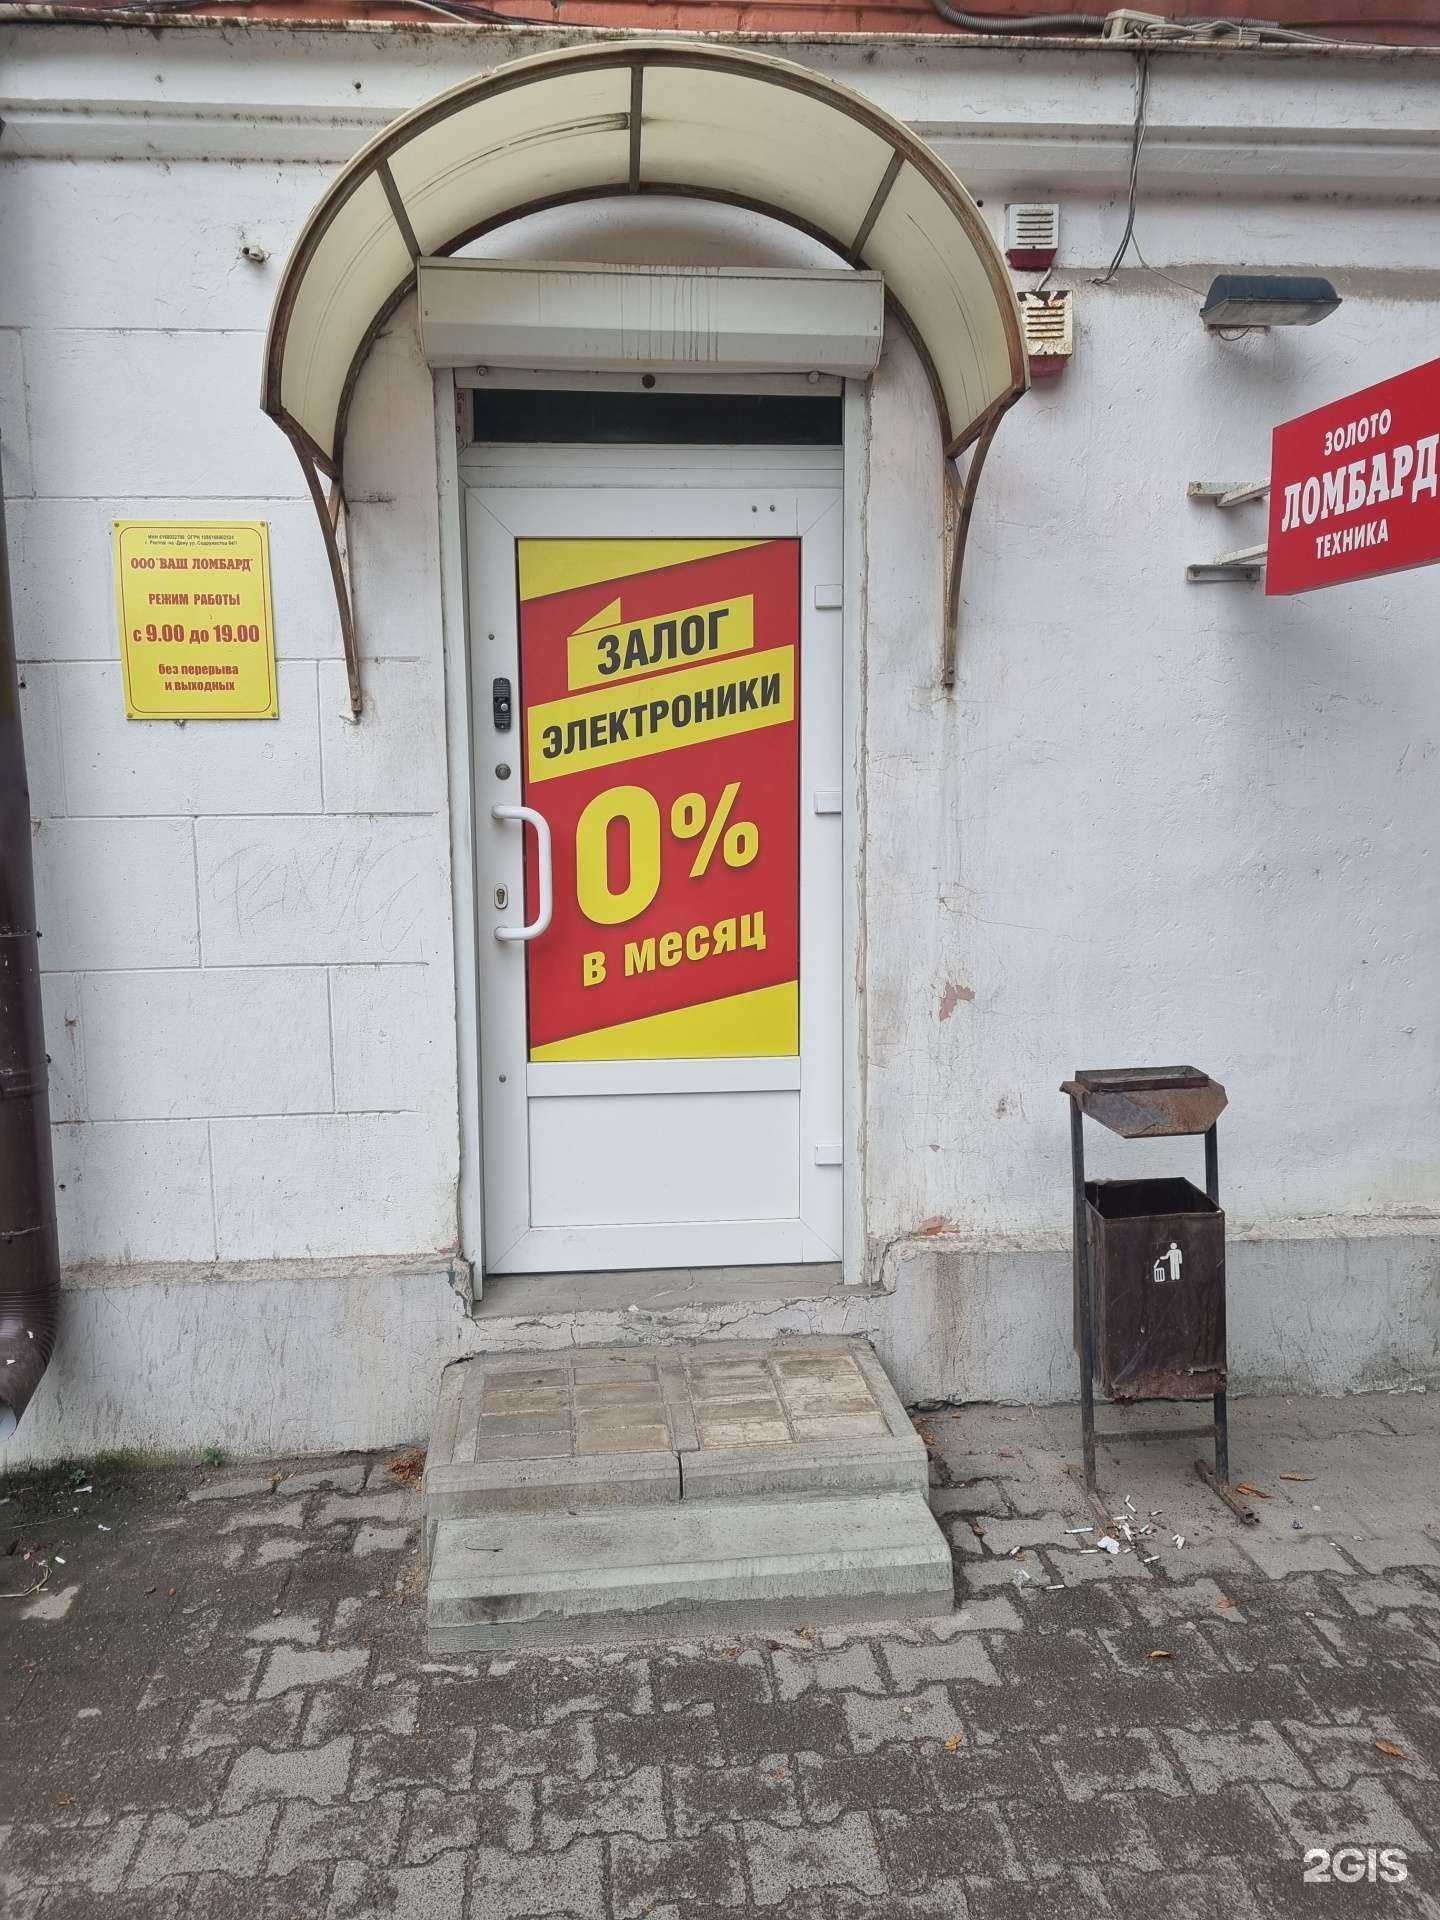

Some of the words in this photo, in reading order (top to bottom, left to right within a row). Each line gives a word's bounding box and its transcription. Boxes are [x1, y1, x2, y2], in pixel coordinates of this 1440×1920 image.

[1324, 408, 1392, 456] ЗОЛОТО
[1281, 433, 1440, 532] ЛОМБАРД
[1316, 518, 1389, 559] ТЕХНИКА
[131, 557, 156, 569] ООО
[148, 593, 189, 606] РЕЖИМ
[194, 593, 241, 606] РАБОТЫ
[145, 624, 185, 642] 9.00
[189, 629, 210, 644] до
[213, 624, 260, 642] 19.00
[597, 608, 730, 676] ЗАЛОГ
[158, 663, 179, 675] без
[181, 665, 239, 676] перерыва
[174, 681, 236, 693] выходных
[542, 672, 781, 760] ЭЛЕКТРОНИКИ
[576, 781, 759, 925] 0%
[583, 950, 606, 988] в
[624, 910, 767, 977] месяц
